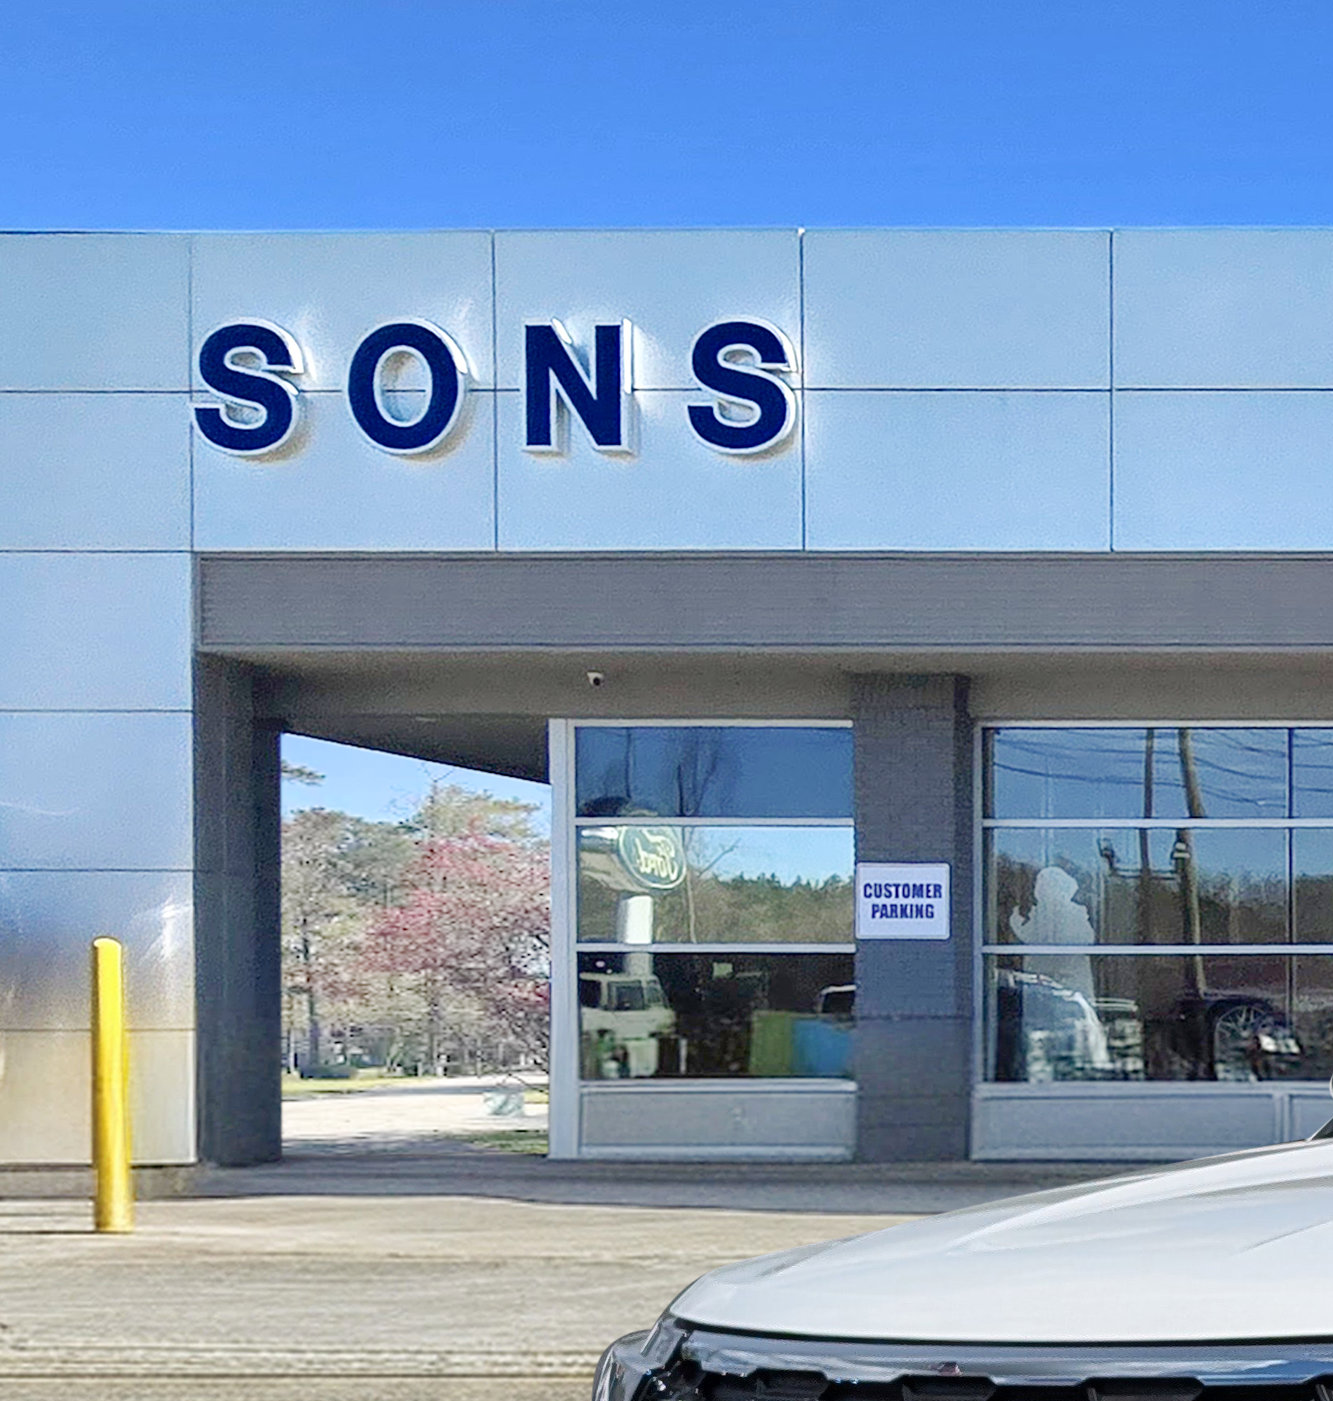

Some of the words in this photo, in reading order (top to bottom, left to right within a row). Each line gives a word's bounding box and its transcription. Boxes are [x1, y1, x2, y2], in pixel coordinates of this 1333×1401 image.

[193, 319, 800, 456] SONS
[863, 882, 943, 899] CUSTOMER
[871, 903, 935, 919] PARKING
